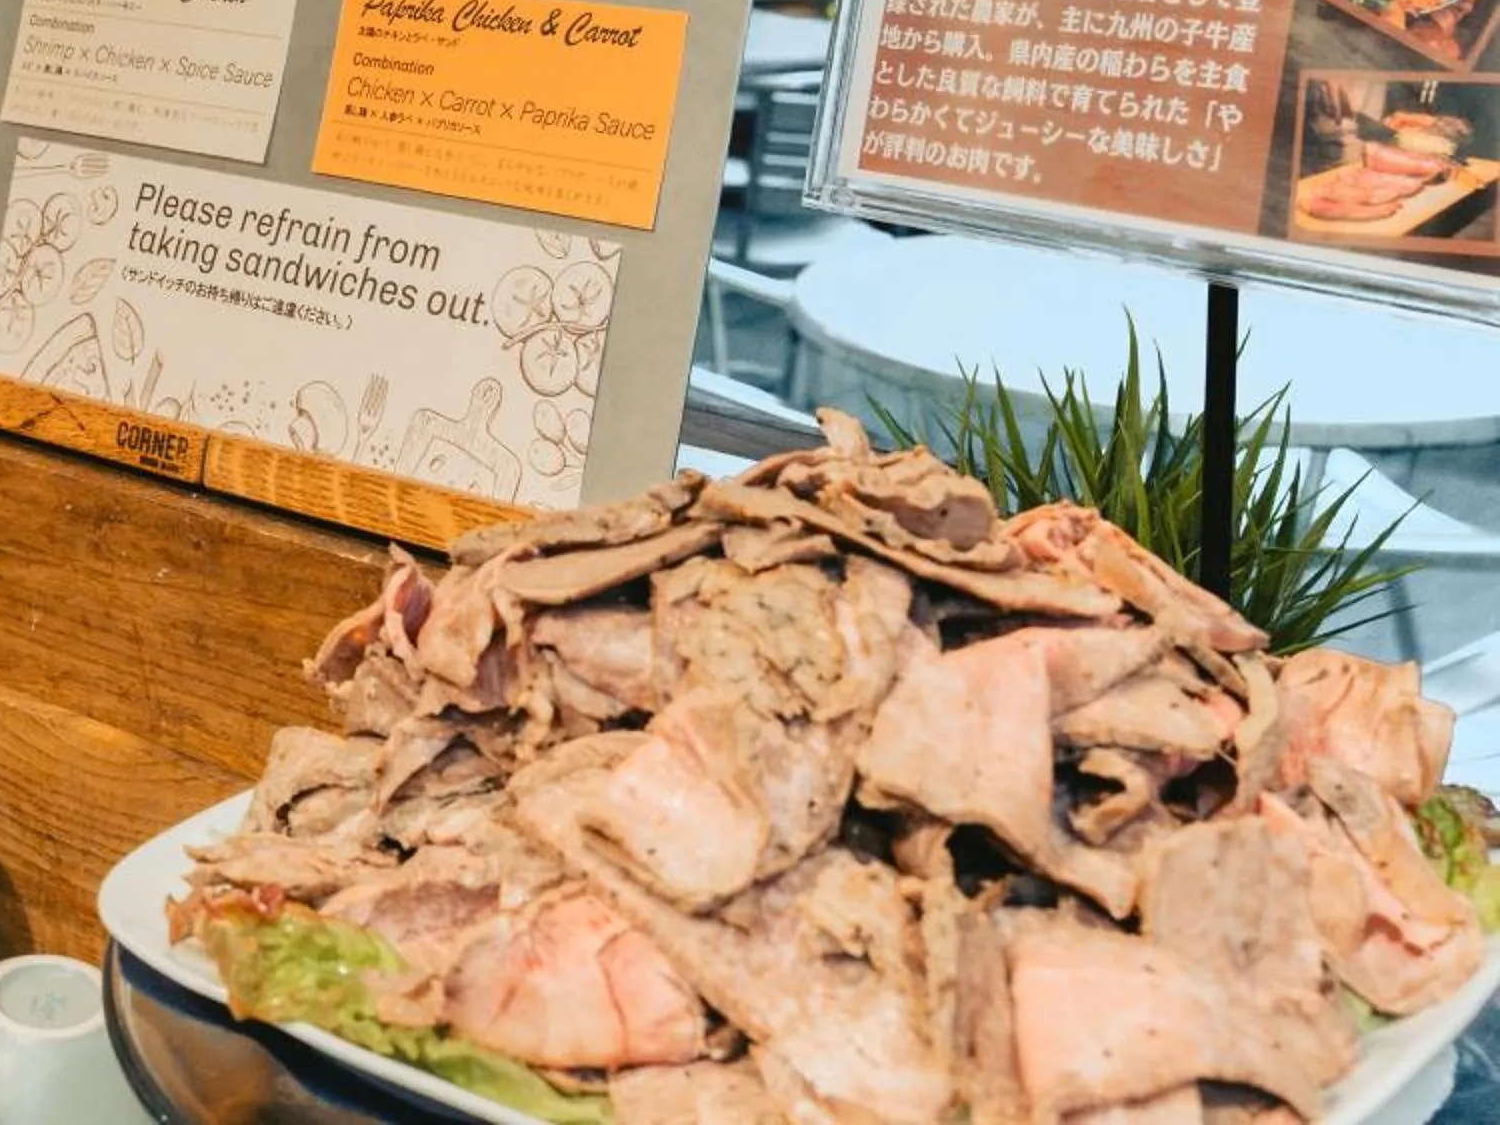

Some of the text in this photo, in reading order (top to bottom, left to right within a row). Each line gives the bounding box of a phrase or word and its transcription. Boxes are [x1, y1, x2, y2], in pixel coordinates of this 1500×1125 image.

[28, 14, 96, 35] Combination
[540, 8, 562, 36] &
[564, 12, 644, 49] Carrot
[23, 34, 77, 62] Shrimp
[95, 44, 155, 72] Chicken
[175, 55, 220, 82] Spice
[223, 62, 274, 88] Sauce
[353, 51, 435, 76] Combination
[879, 23, 1250, 93] 地から購入。県内産の稲わらを主食
[347, 76, 415, 104] Chicken
[439, 90, 497, 118] Carrot
[519, 100, 589, 132] Paprika
[594, 111, 656, 141] Sauce
[875, 59, 1243, 133] とした良質な飼料で育てられた「や
[862, 131, 1042, 184] が評判のお肉です。
[868, 96, 1222, 172] わらかくてジューシーな美味しさ」
[135, 182, 441, 272] Please refrain from
[128, 221, 491, 327] taking sandwiches out.
[116, 421, 189, 460] CORNER
